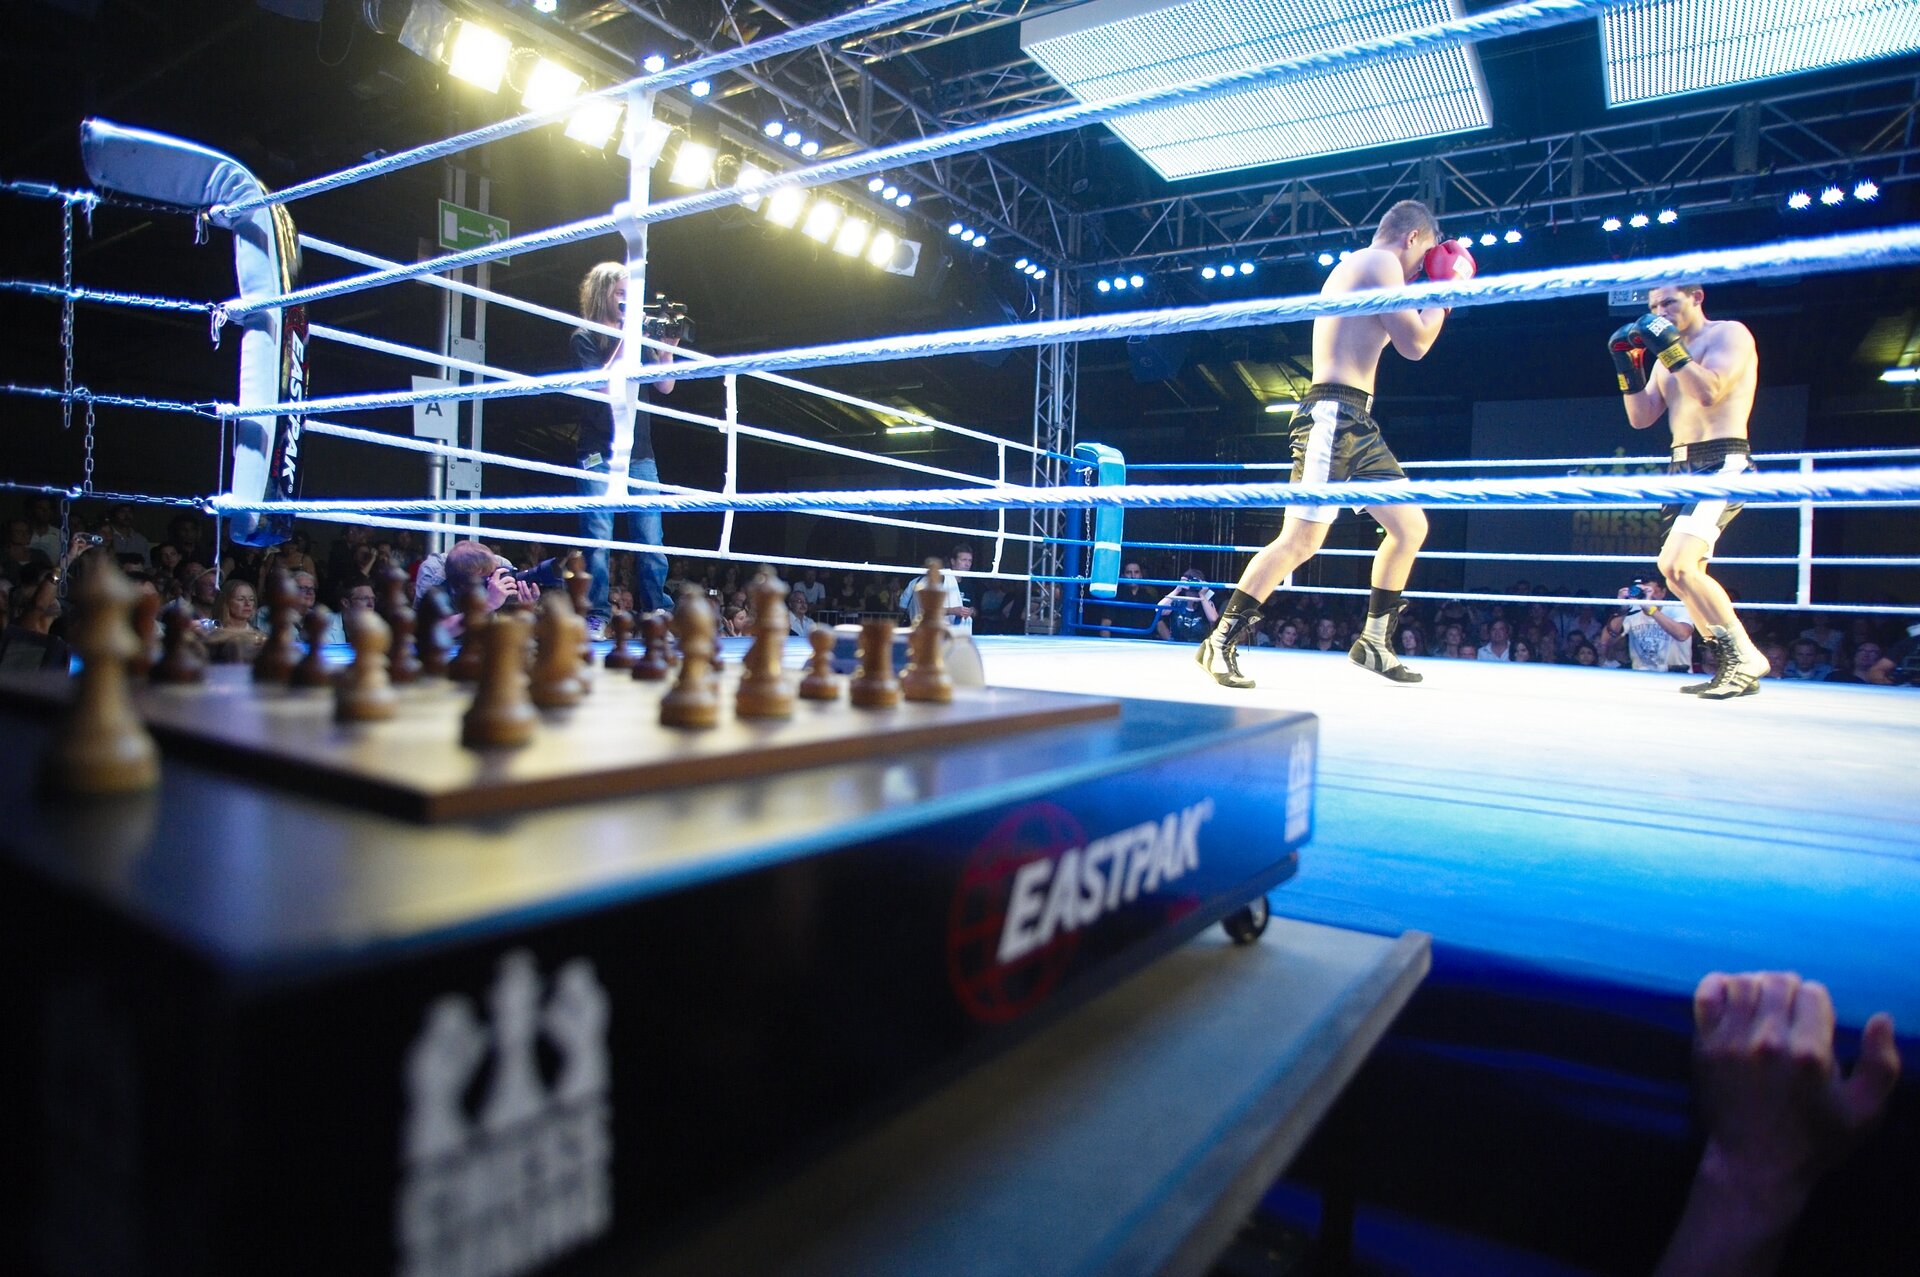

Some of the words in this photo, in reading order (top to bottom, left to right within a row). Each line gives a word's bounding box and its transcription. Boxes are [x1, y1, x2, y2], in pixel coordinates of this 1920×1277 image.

[425, 401, 443, 417] A
[1572, 510, 1661, 536] CHESS
[996, 799, 1206, 964] EASTPAK
